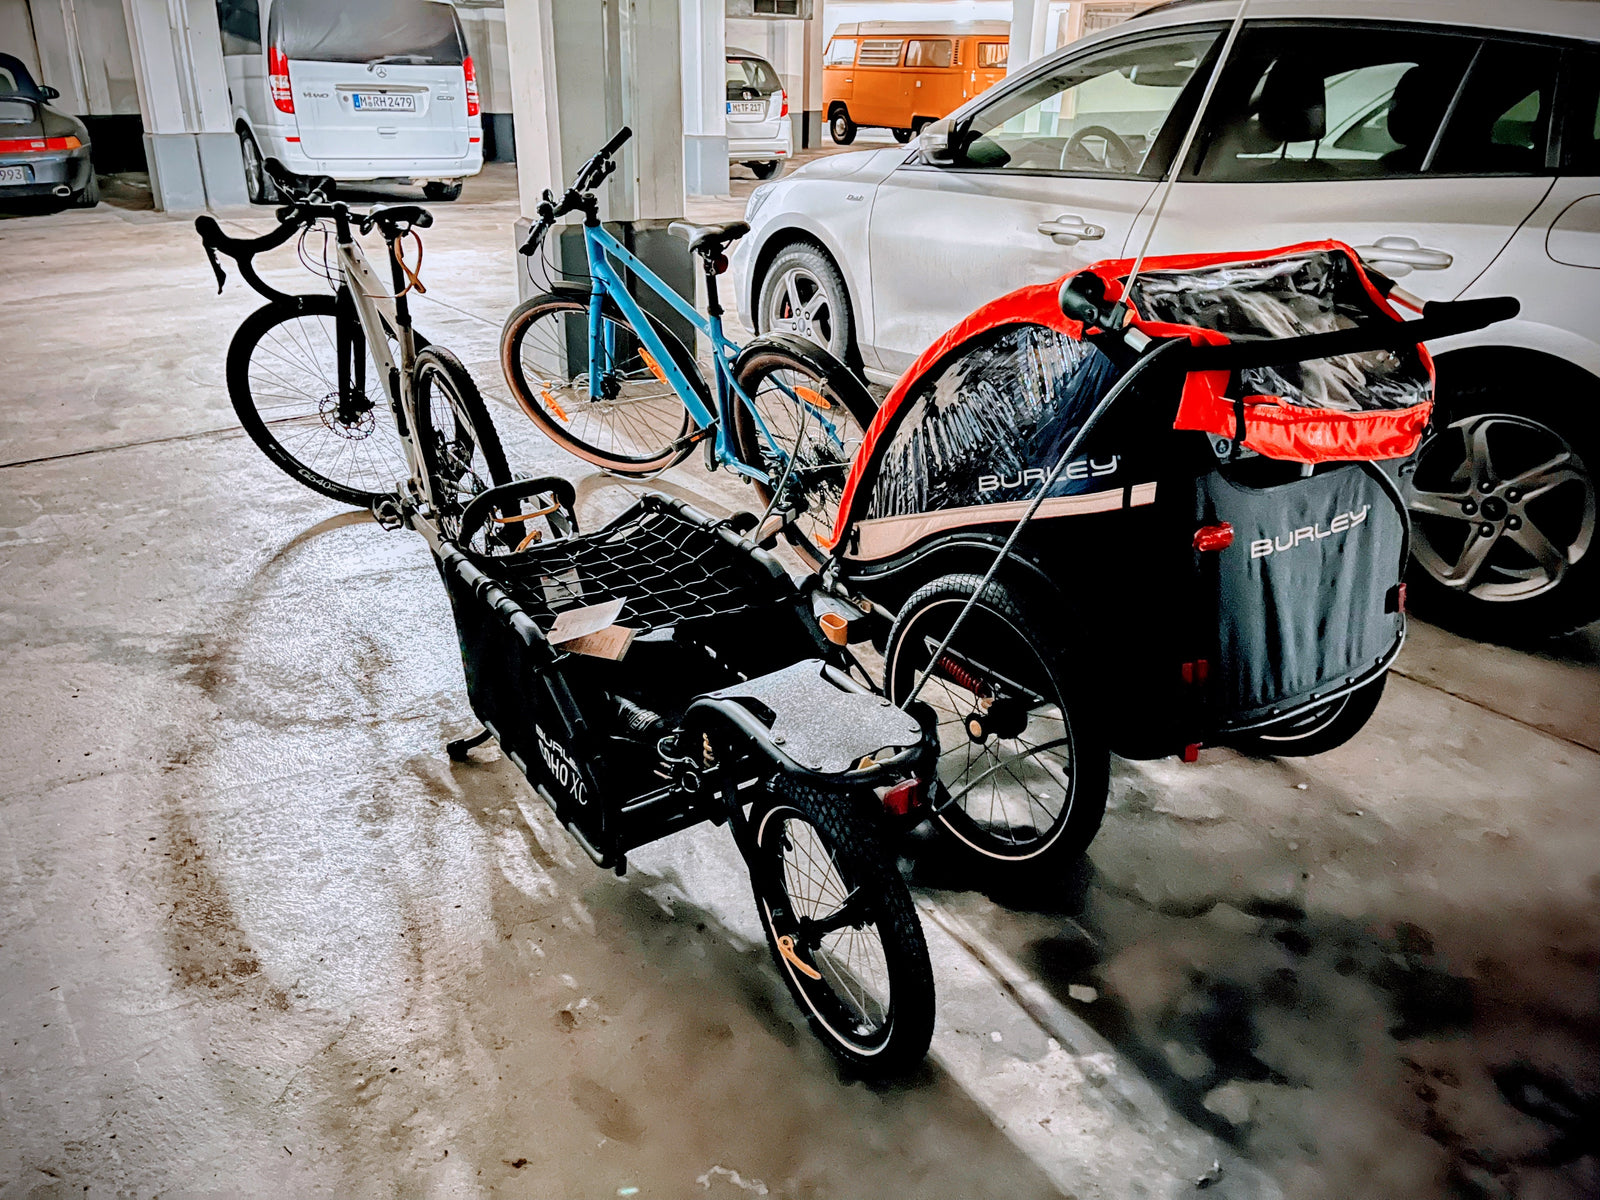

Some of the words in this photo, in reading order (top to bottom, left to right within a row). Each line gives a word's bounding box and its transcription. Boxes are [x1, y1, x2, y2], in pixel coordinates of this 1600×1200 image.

[388, 97, 412, 107] 2479
[978, 455, 1119, 493] BURLEY
[1251, 505, 1369, 559] BURLEY
[569, 772, 588, 806] XC
